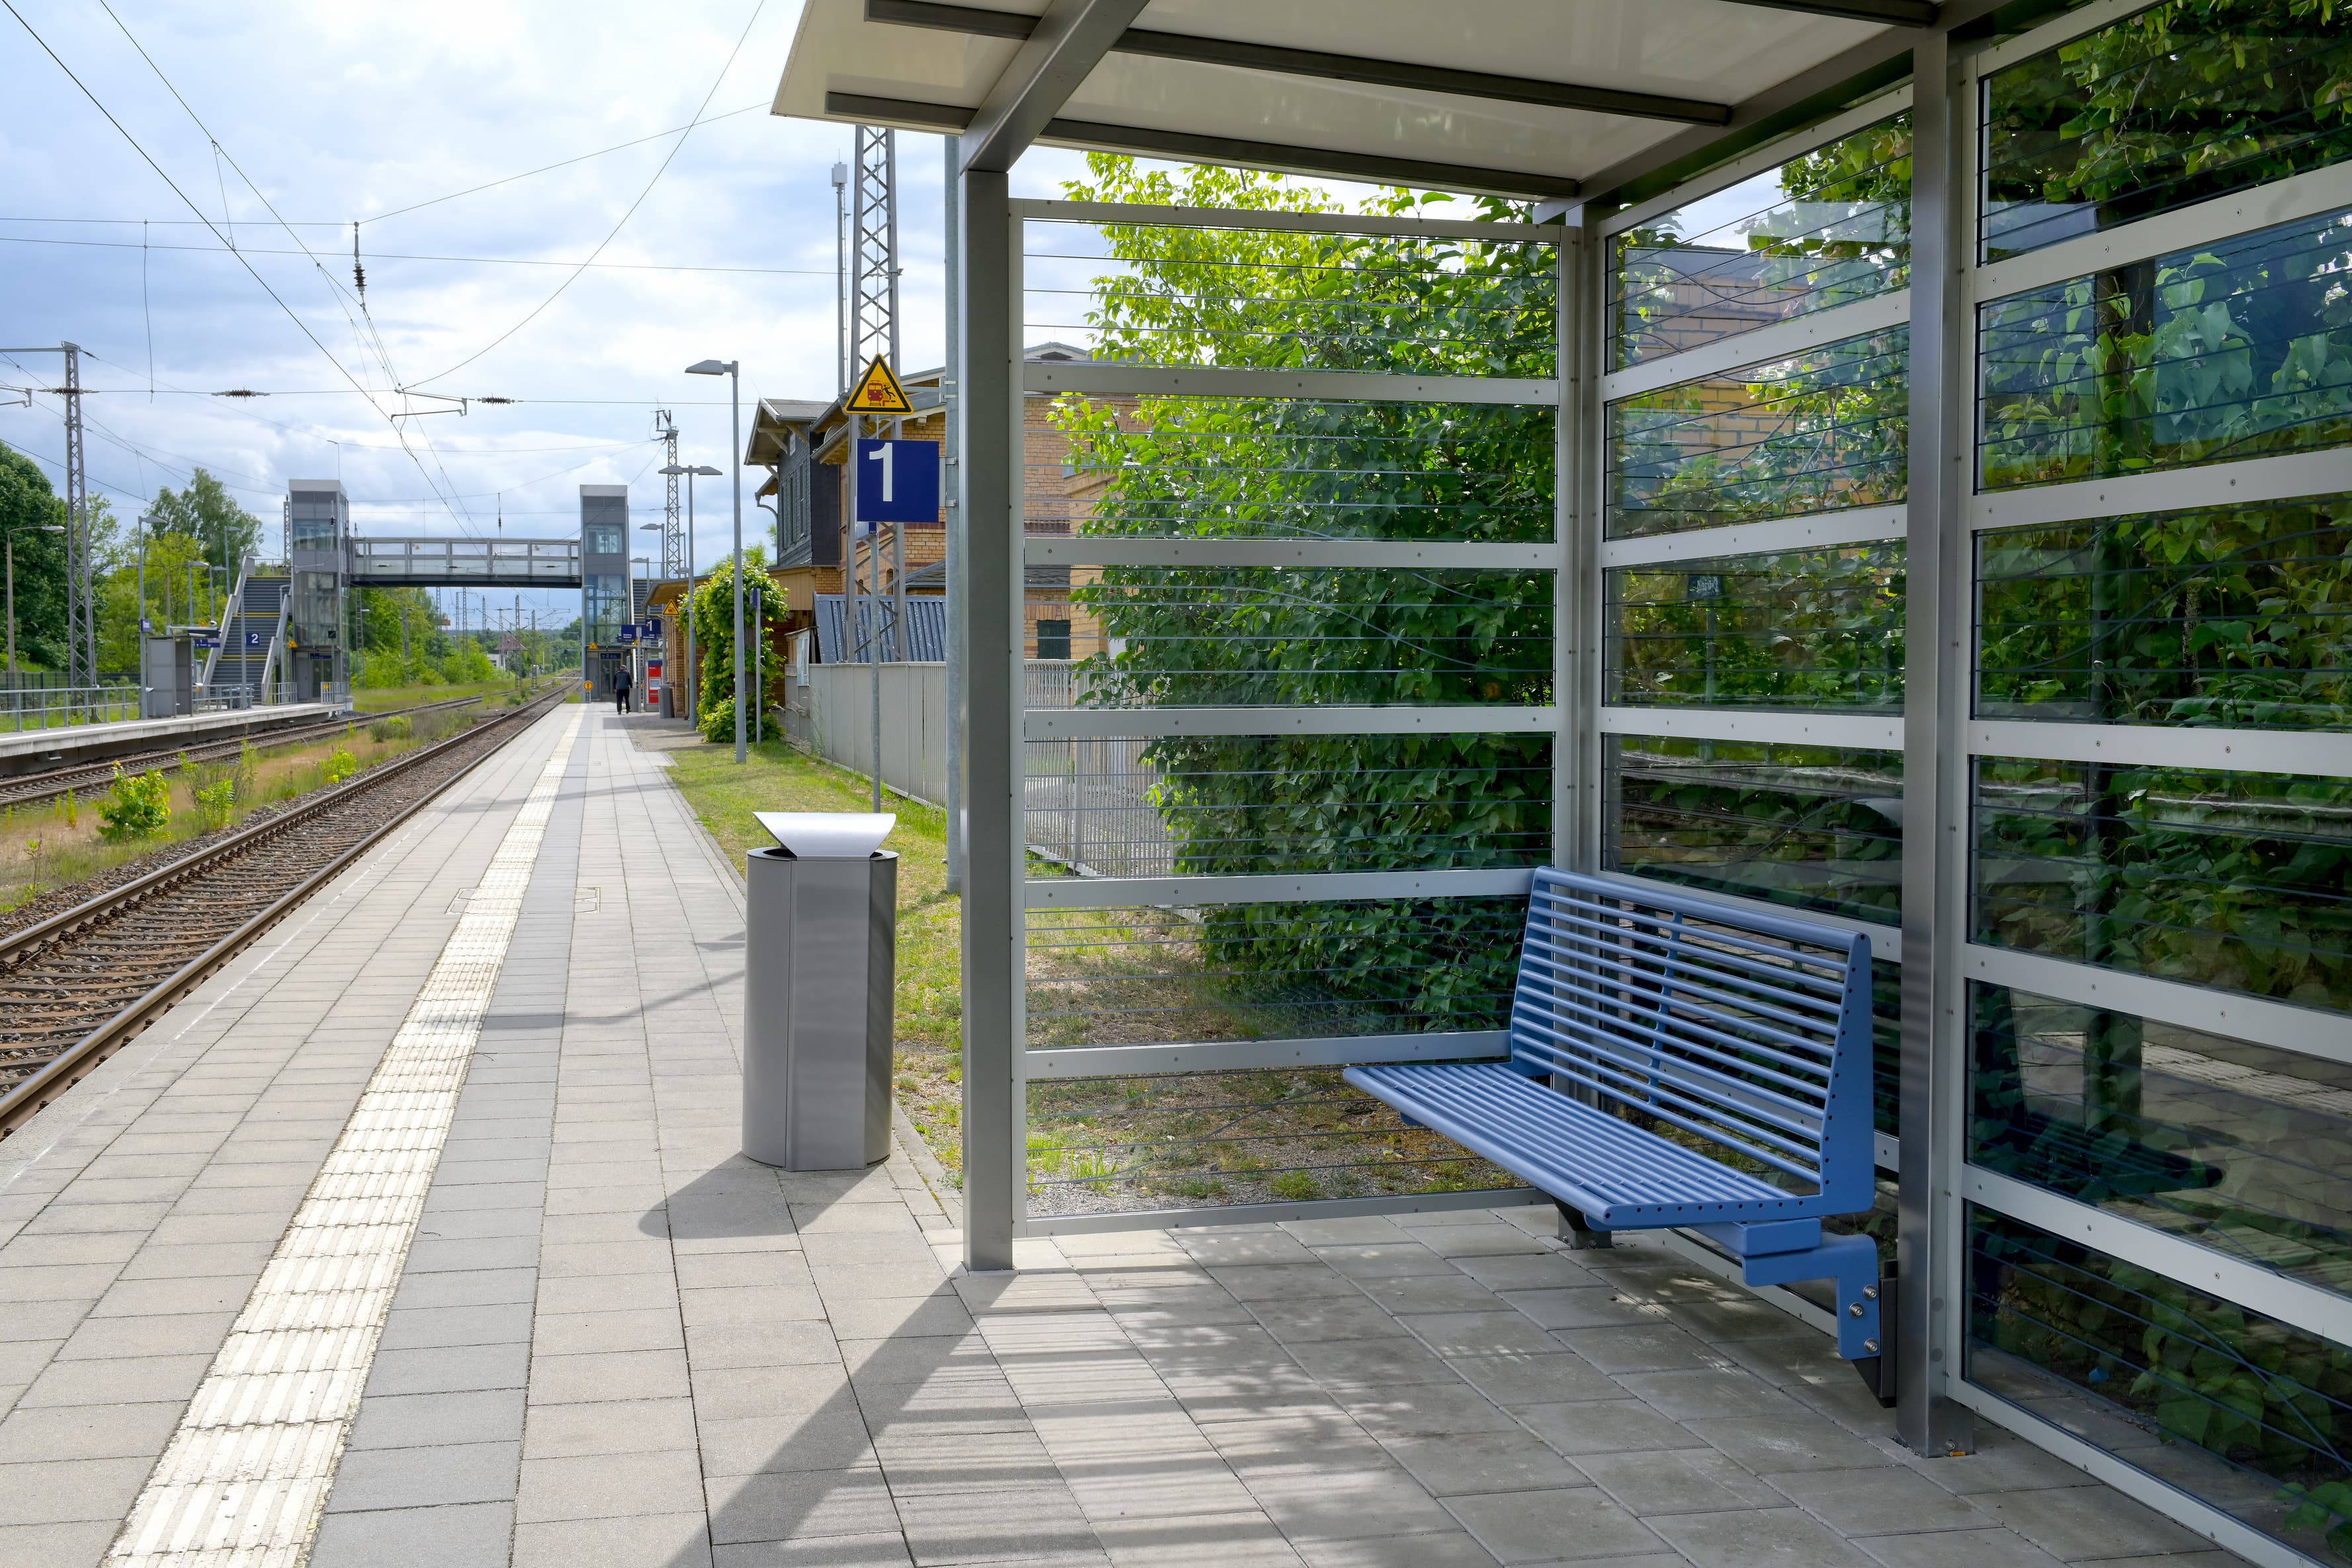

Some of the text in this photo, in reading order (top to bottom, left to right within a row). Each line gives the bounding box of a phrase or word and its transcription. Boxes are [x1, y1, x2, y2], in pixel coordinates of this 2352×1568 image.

[869, 442, 893, 502] 1
[647, 620, 652, 631] 1
[251, 633, 259, 643] 2
